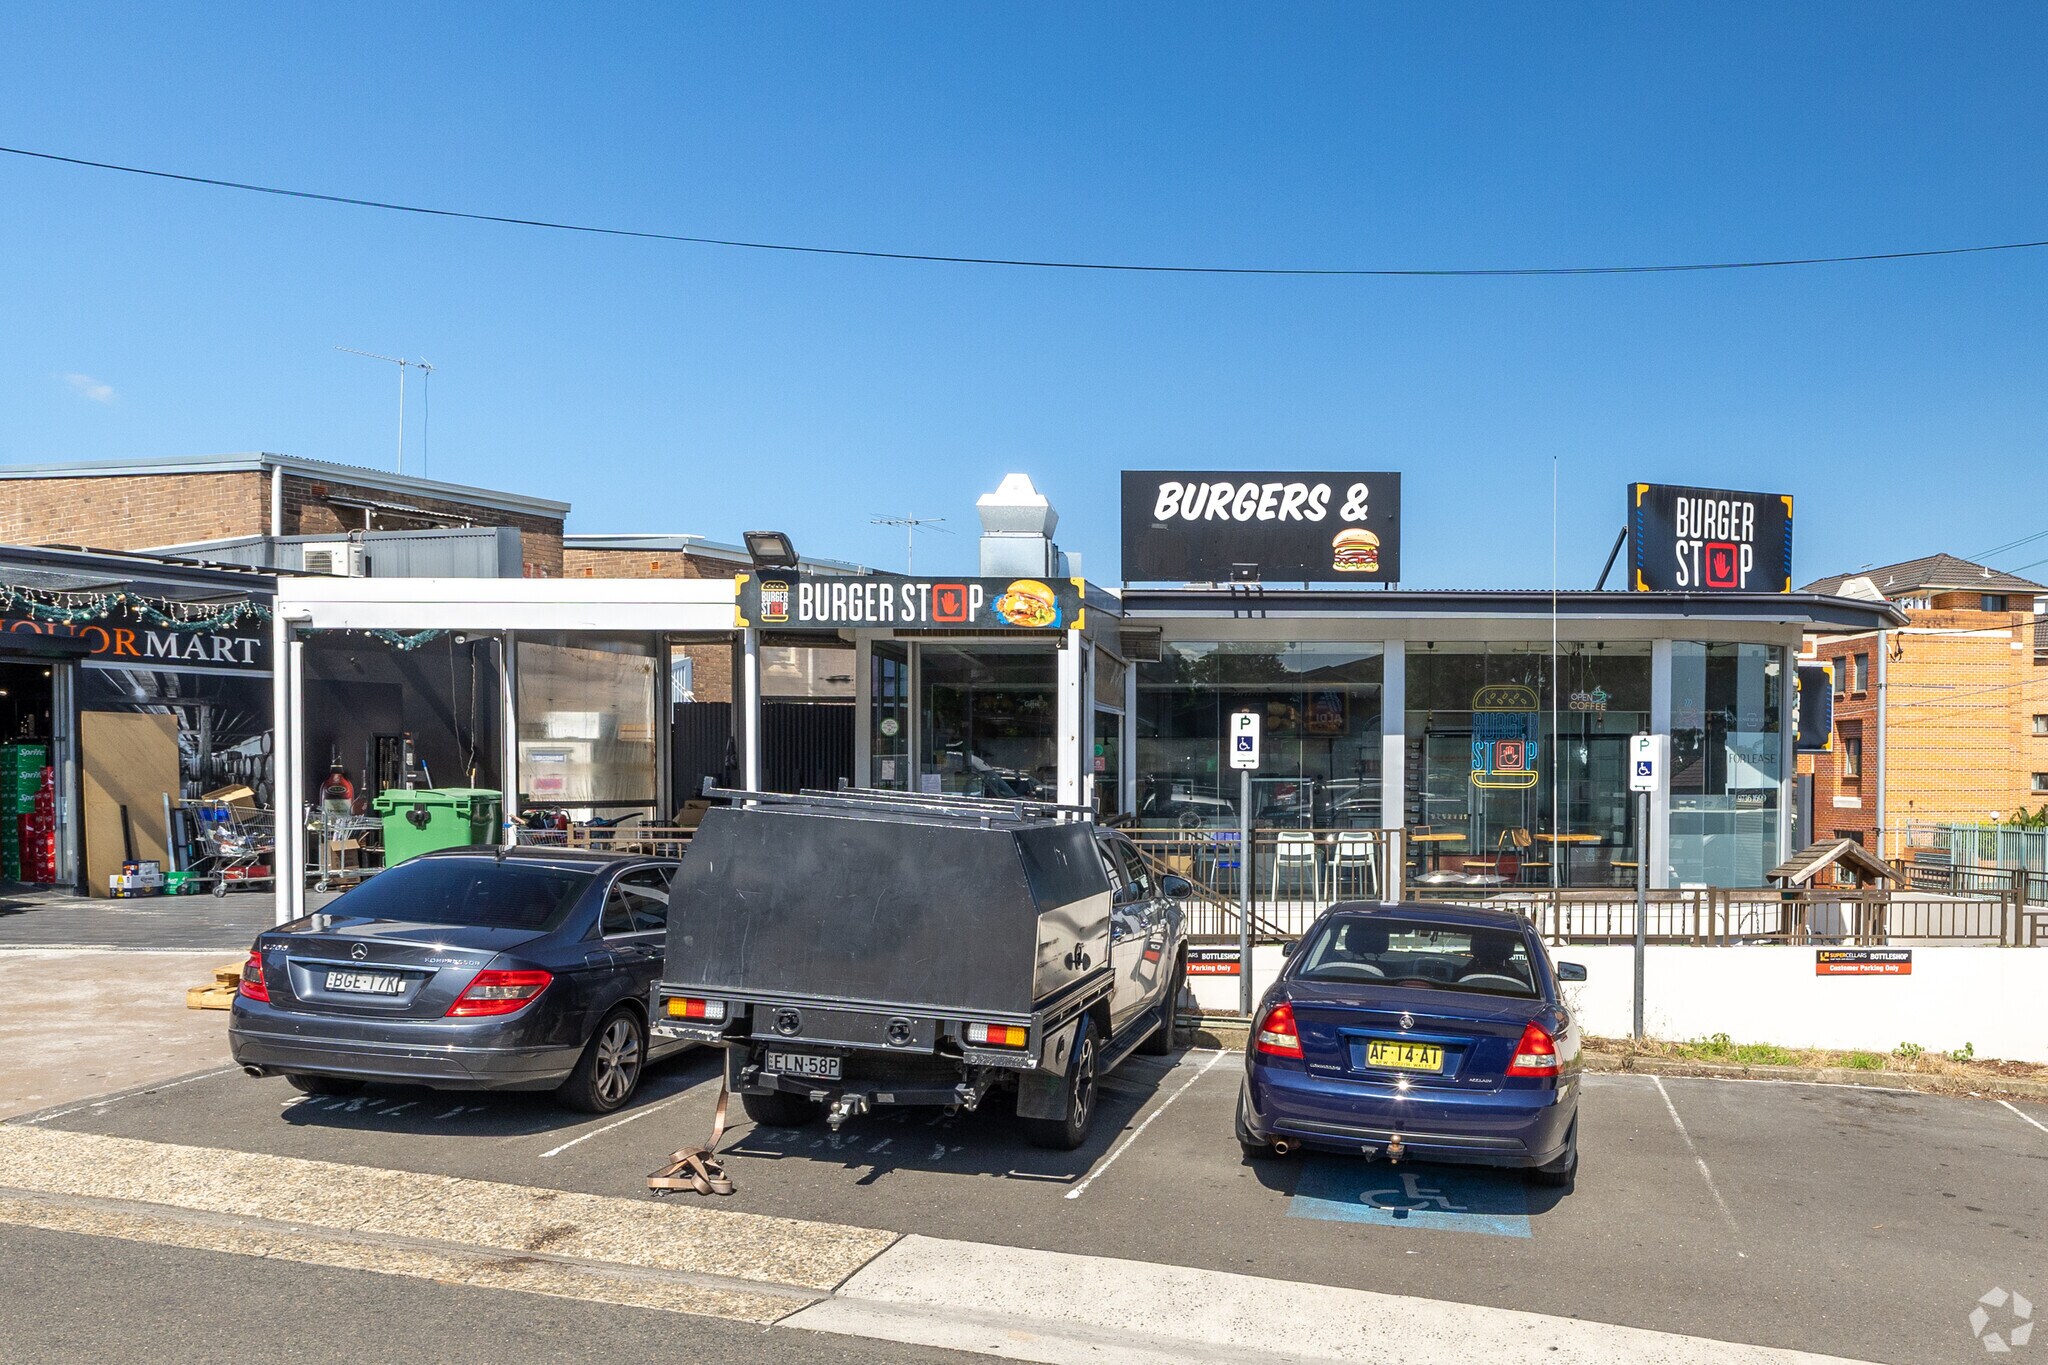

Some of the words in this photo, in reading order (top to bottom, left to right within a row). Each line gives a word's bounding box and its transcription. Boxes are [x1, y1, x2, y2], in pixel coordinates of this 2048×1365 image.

[1154, 481, 1332, 522] BURGERS
[1340, 482, 1369, 522] &
[1676, 496, 1755, 542] BURGER
[1675, 539, 1754, 590] STOP
[761, 591, 789, 603] BURGER
[799, 582, 893, 622] BURGER
[901, 583, 983, 623] STOP
[1570, 692, 1593, 702] OPEN
[1569, 701, 1607, 711] COFFEE
[1240, 716, 1251, 730] P
[1473, 713, 1538, 740] BURGER
[1639, 739, 1650, 752] P
[1728, 753, 1746, 763] FOR
[1747, 753, 1777, 764] LEASE
[1885, 964, 1899, 972] Only
